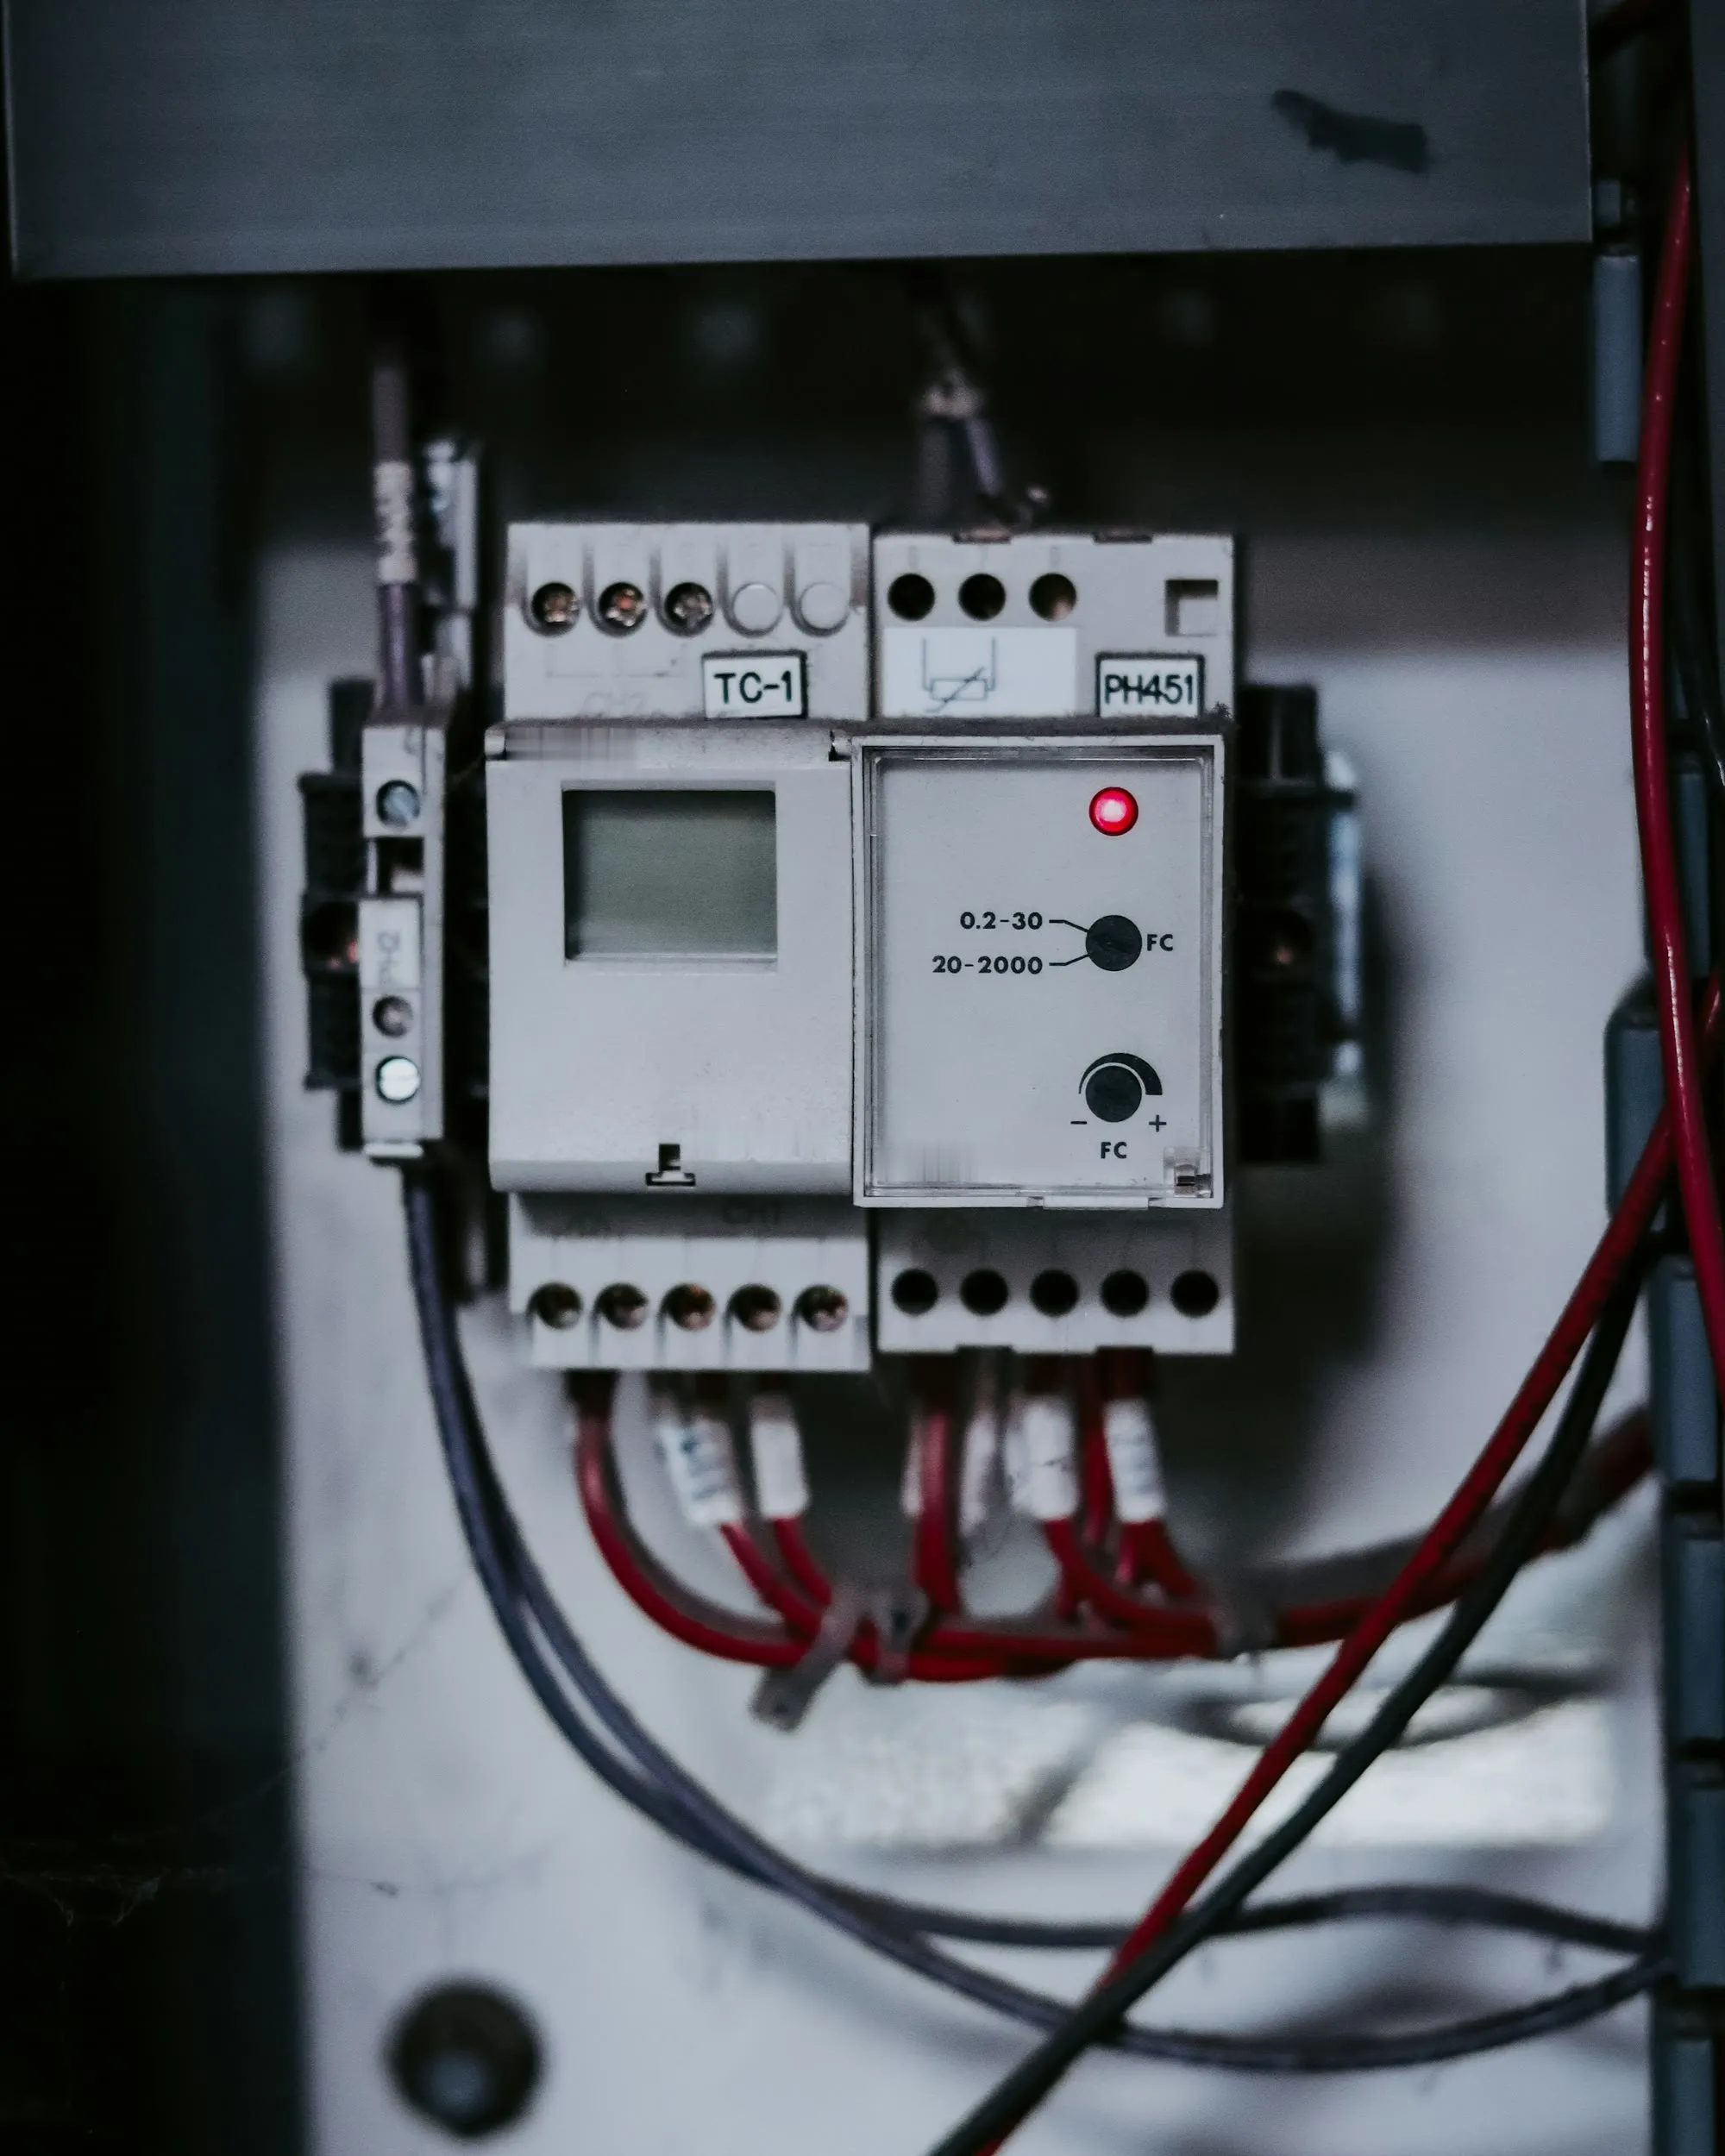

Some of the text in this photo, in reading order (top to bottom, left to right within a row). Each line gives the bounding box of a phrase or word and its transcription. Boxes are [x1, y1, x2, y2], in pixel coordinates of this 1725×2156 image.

[713, 670, 793, 704] TC-1
[1104, 674, 1193, 705] PH451
[960, 911, 1043, 931] 0.2-30
[1146, 933, 1174, 952] FC
[932, 955, 1044, 975] 20-2000
[1101, 1141, 1128, 1159] FC
